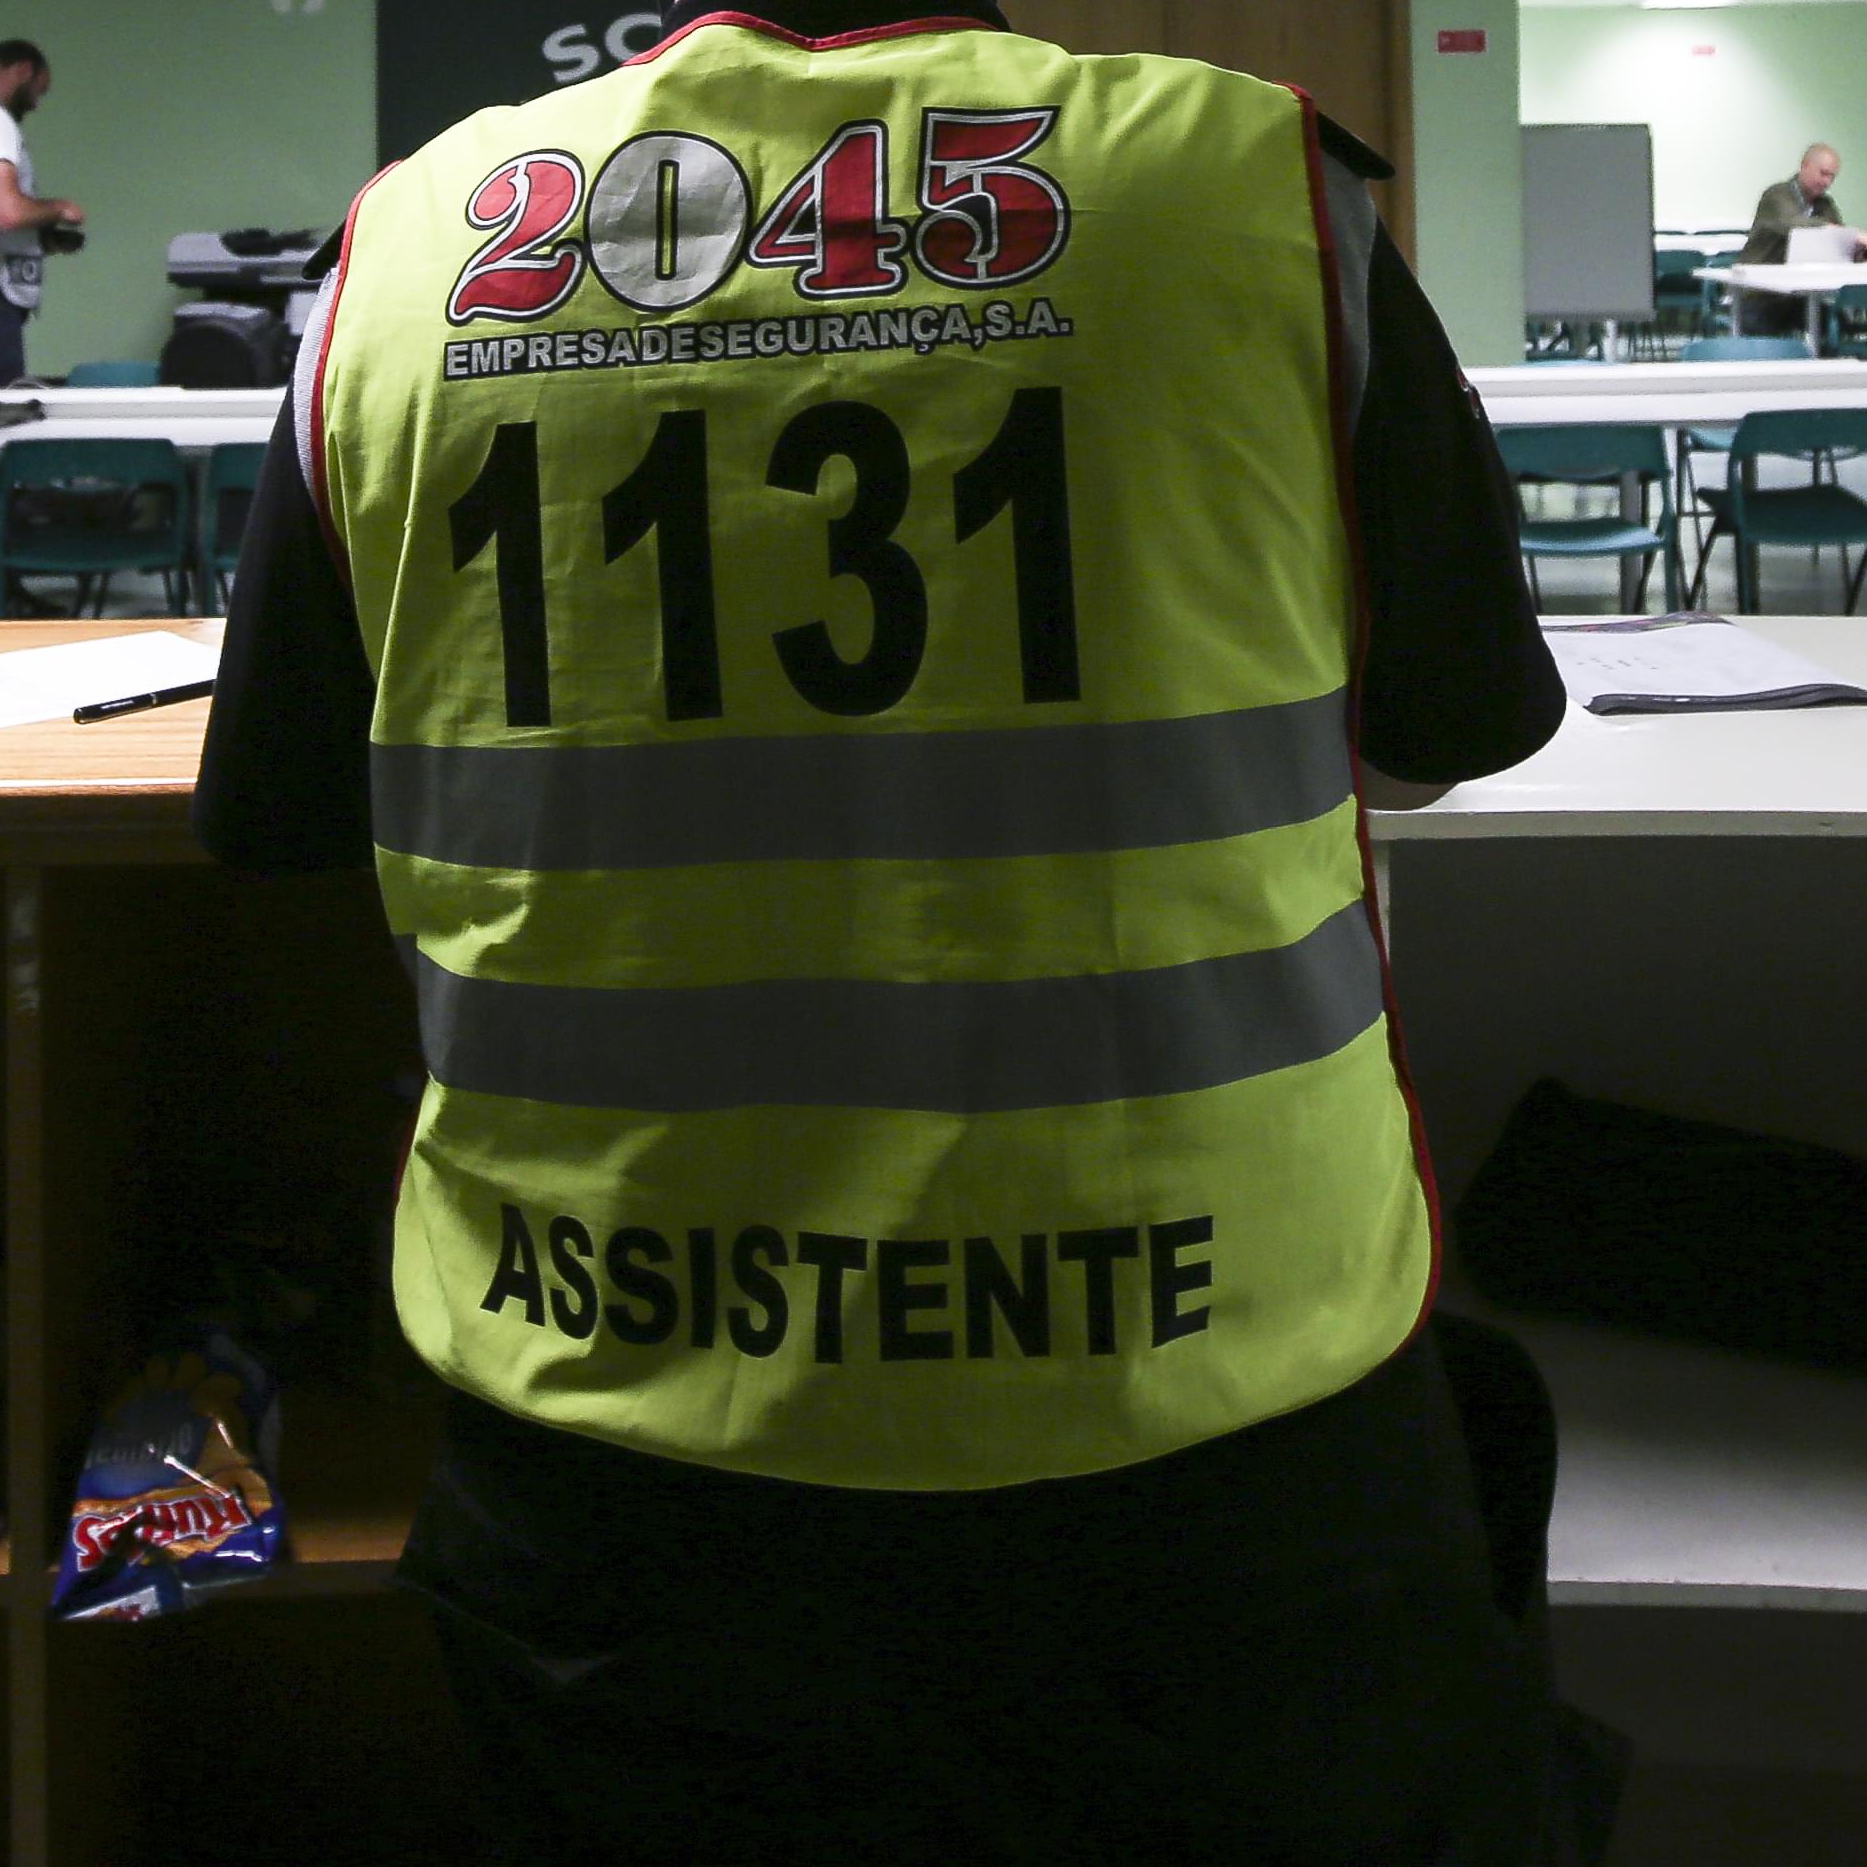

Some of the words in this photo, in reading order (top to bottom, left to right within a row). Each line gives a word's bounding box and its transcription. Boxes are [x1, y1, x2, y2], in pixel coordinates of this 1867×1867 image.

[445, 105, 1071, 326] 2045
[448, 387, 1081, 728] 1131
[480, 1203, 1214, 1364] ASSISTENTE
